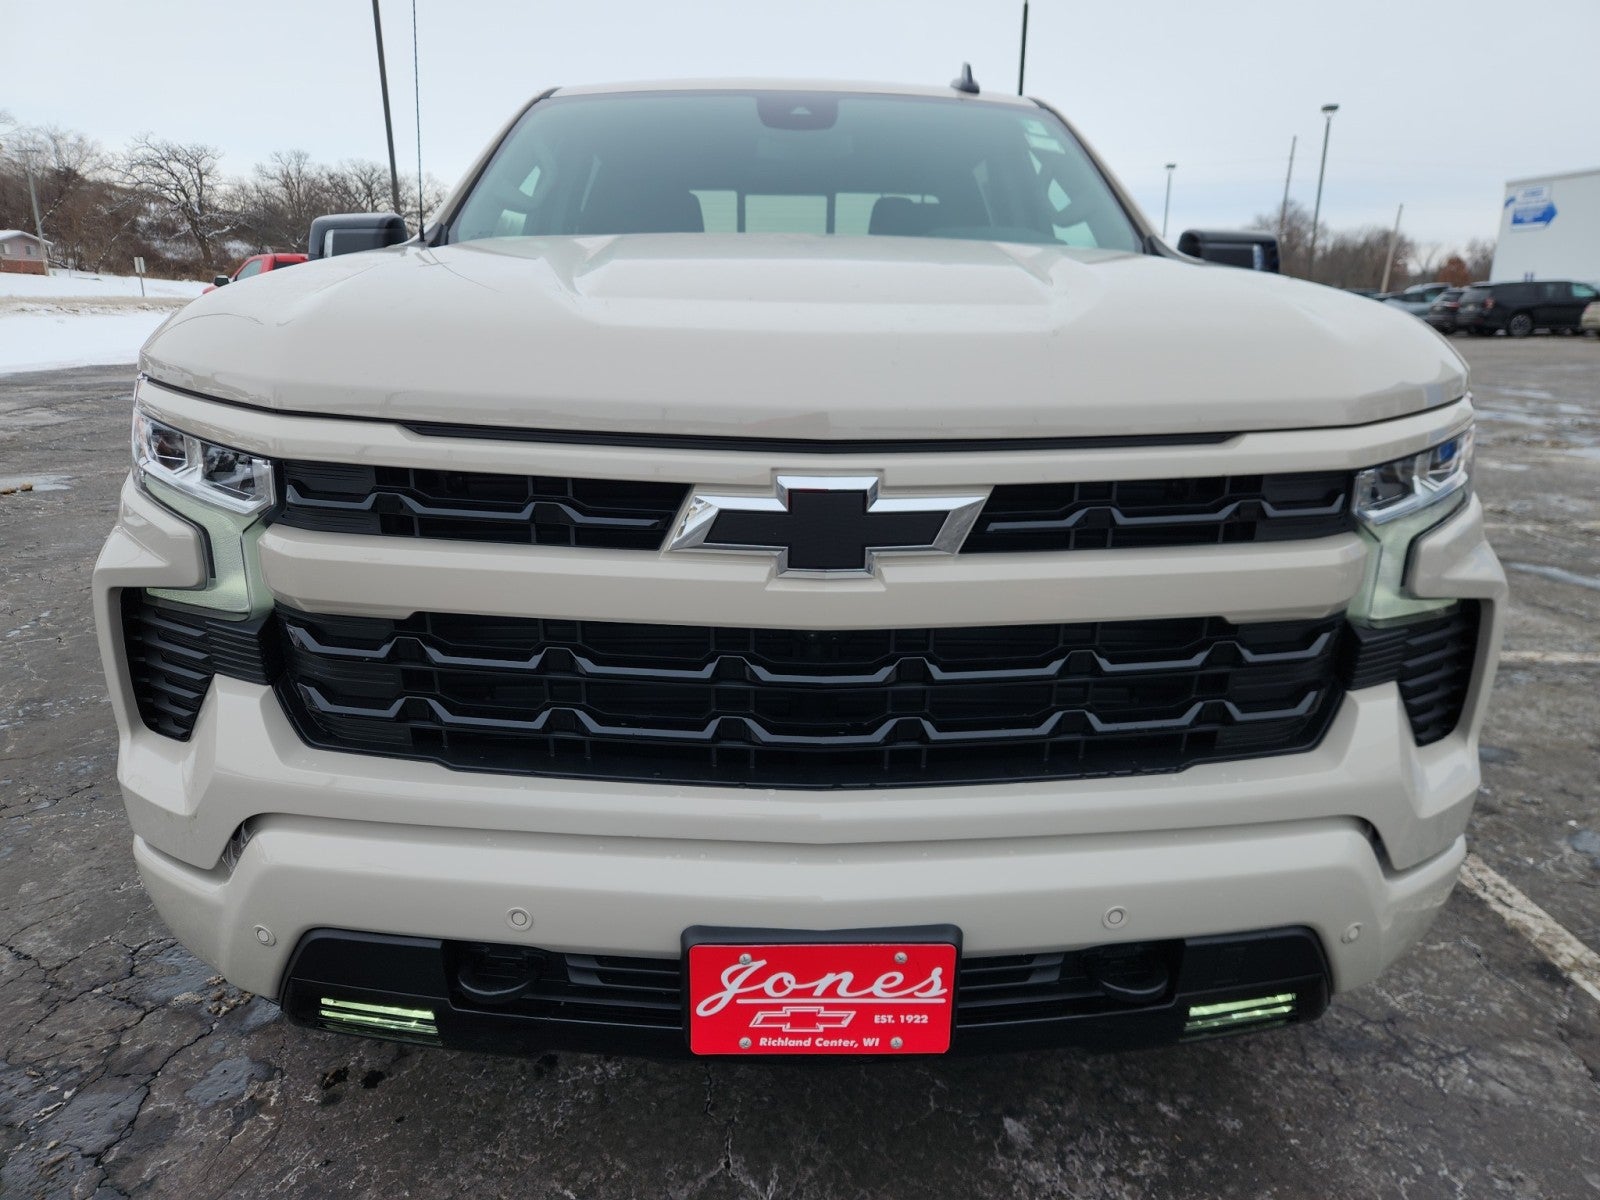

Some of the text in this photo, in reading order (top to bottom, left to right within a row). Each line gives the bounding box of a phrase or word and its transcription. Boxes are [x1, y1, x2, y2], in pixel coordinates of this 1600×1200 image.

[696, 959, 948, 1017] Jones
[874, 1014, 929, 1024] EST. 1922
[759, 1037, 880, 1049] Richland Center, WI
